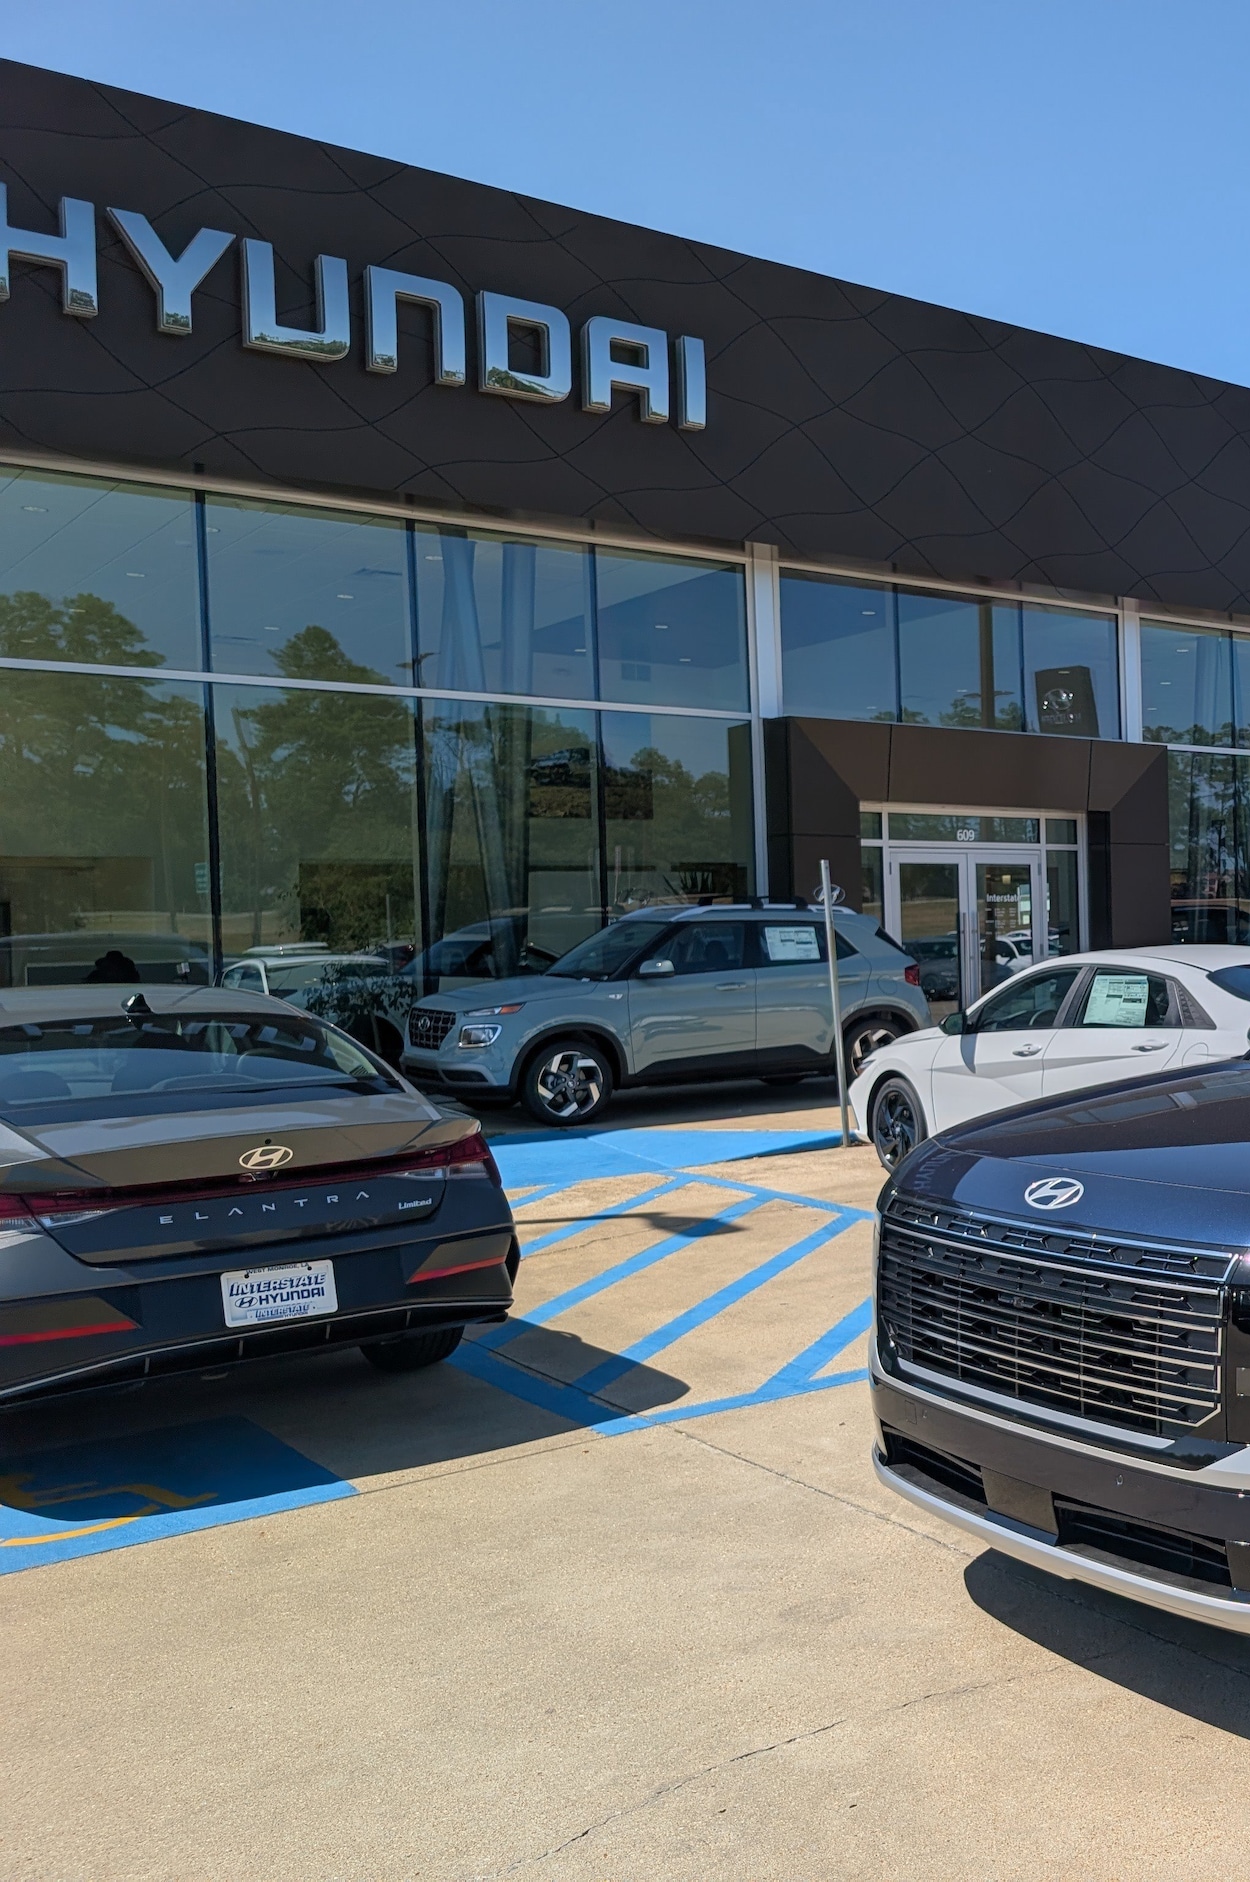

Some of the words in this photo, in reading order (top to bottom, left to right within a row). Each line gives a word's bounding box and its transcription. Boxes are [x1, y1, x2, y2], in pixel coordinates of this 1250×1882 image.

[0, 181, 706, 431] HYUNDAI
[957, 829, 975, 841] 609
[159, 1191, 369, 1224] ELANTRA
[398, 1198, 432, 1210] Limited
[229, 1272, 326, 1297] INTERSTATE
[259, 1287, 325, 1305] HYUNDAI
